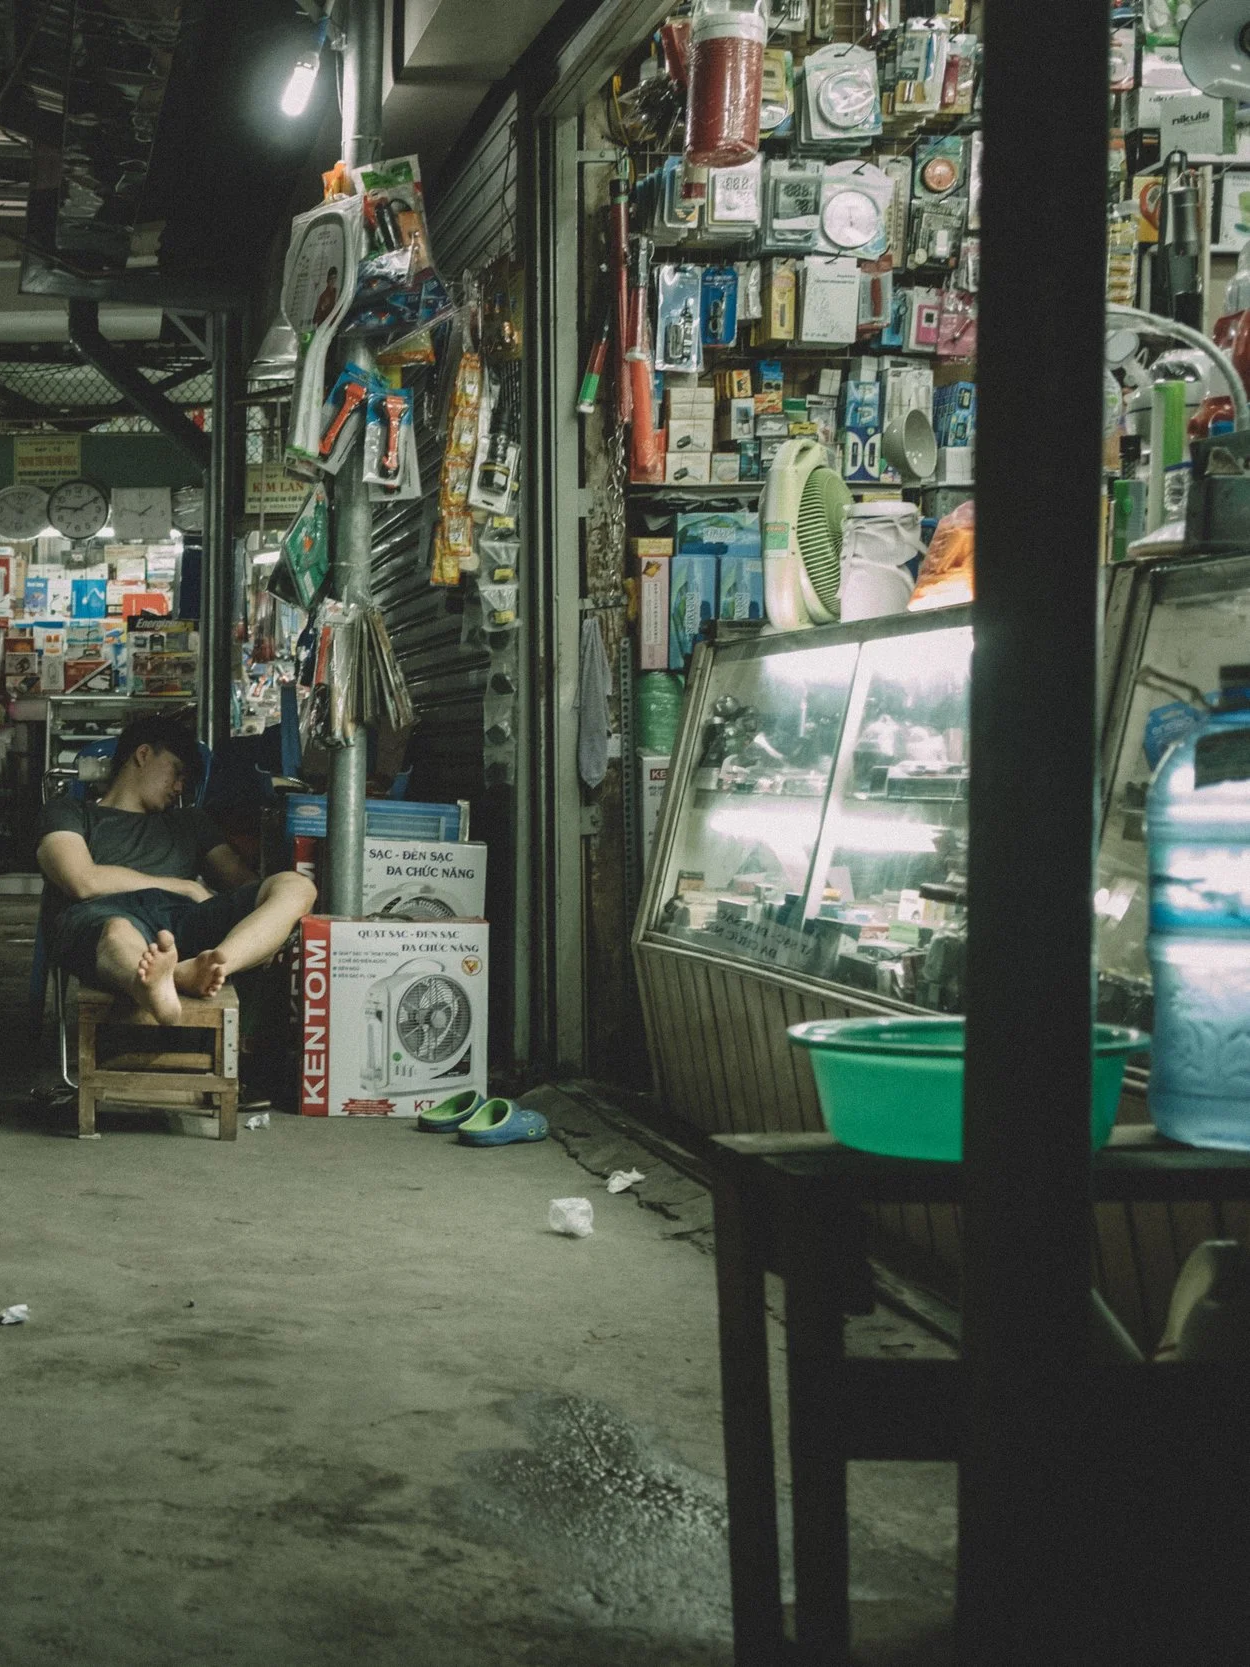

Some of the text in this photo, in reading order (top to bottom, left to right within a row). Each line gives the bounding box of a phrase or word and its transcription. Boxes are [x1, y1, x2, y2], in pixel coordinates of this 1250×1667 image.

[253, 481, 275, 493] KM
[370, 849, 393, 860] SẠC
[430, 851, 454, 863] SẠC
[386, 866, 403, 876] ĐA
[303, 939, 327, 1105] KENTOM
